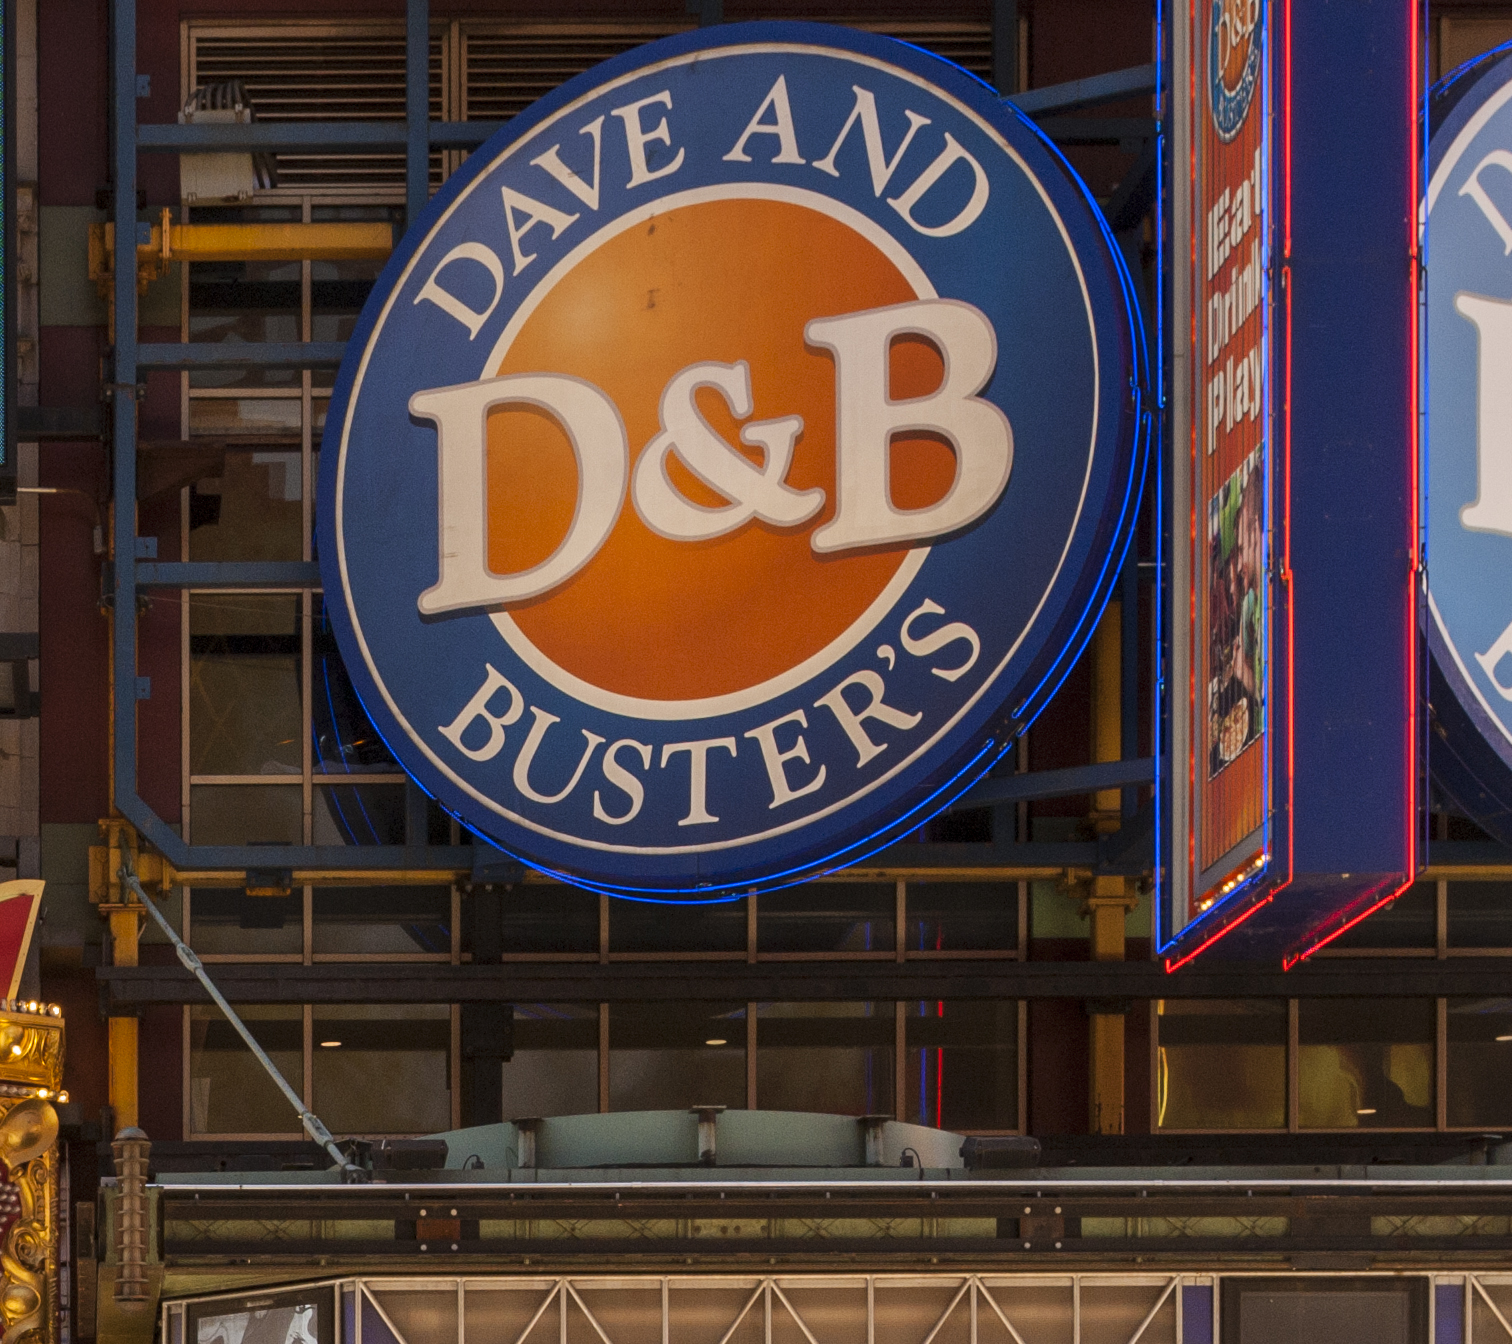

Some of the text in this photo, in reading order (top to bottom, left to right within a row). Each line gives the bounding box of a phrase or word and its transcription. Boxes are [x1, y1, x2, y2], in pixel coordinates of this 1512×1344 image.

[413, 73, 993, 341] DAVE AND
[406, 296, 1016, 620] D&B
[437, 594, 988, 829] BUSTER'S
